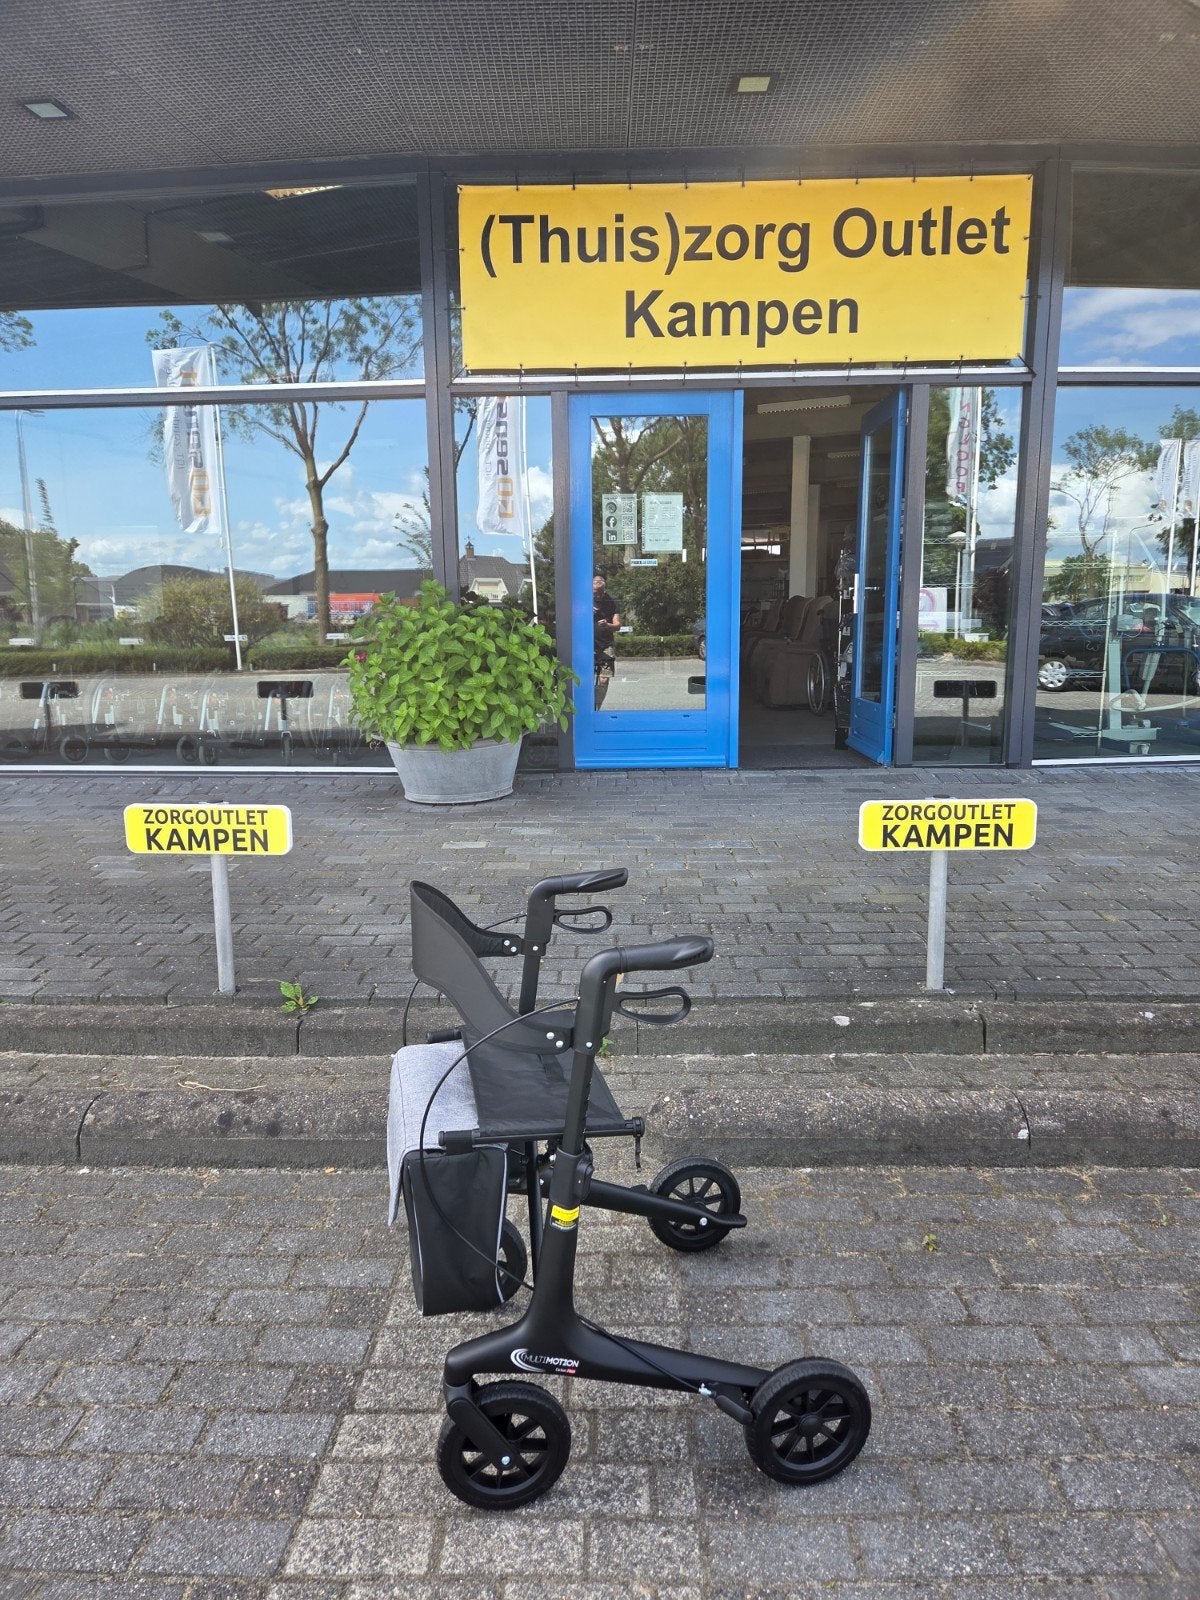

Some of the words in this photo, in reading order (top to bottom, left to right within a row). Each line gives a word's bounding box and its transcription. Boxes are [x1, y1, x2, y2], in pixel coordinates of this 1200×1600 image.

[480, 212, 811, 278] (Thuis)zorg
[832, 205, 1011, 259] Outlet
[625, 289, 859, 348] Kampen
[143, 809, 268, 825] ZORGOUTLET
[882, 803, 1016, 821] ZORGOUTLET
[145, 828, 269, 852] KAMPEN
[882, 823, 1014, 848] KAMPEN
